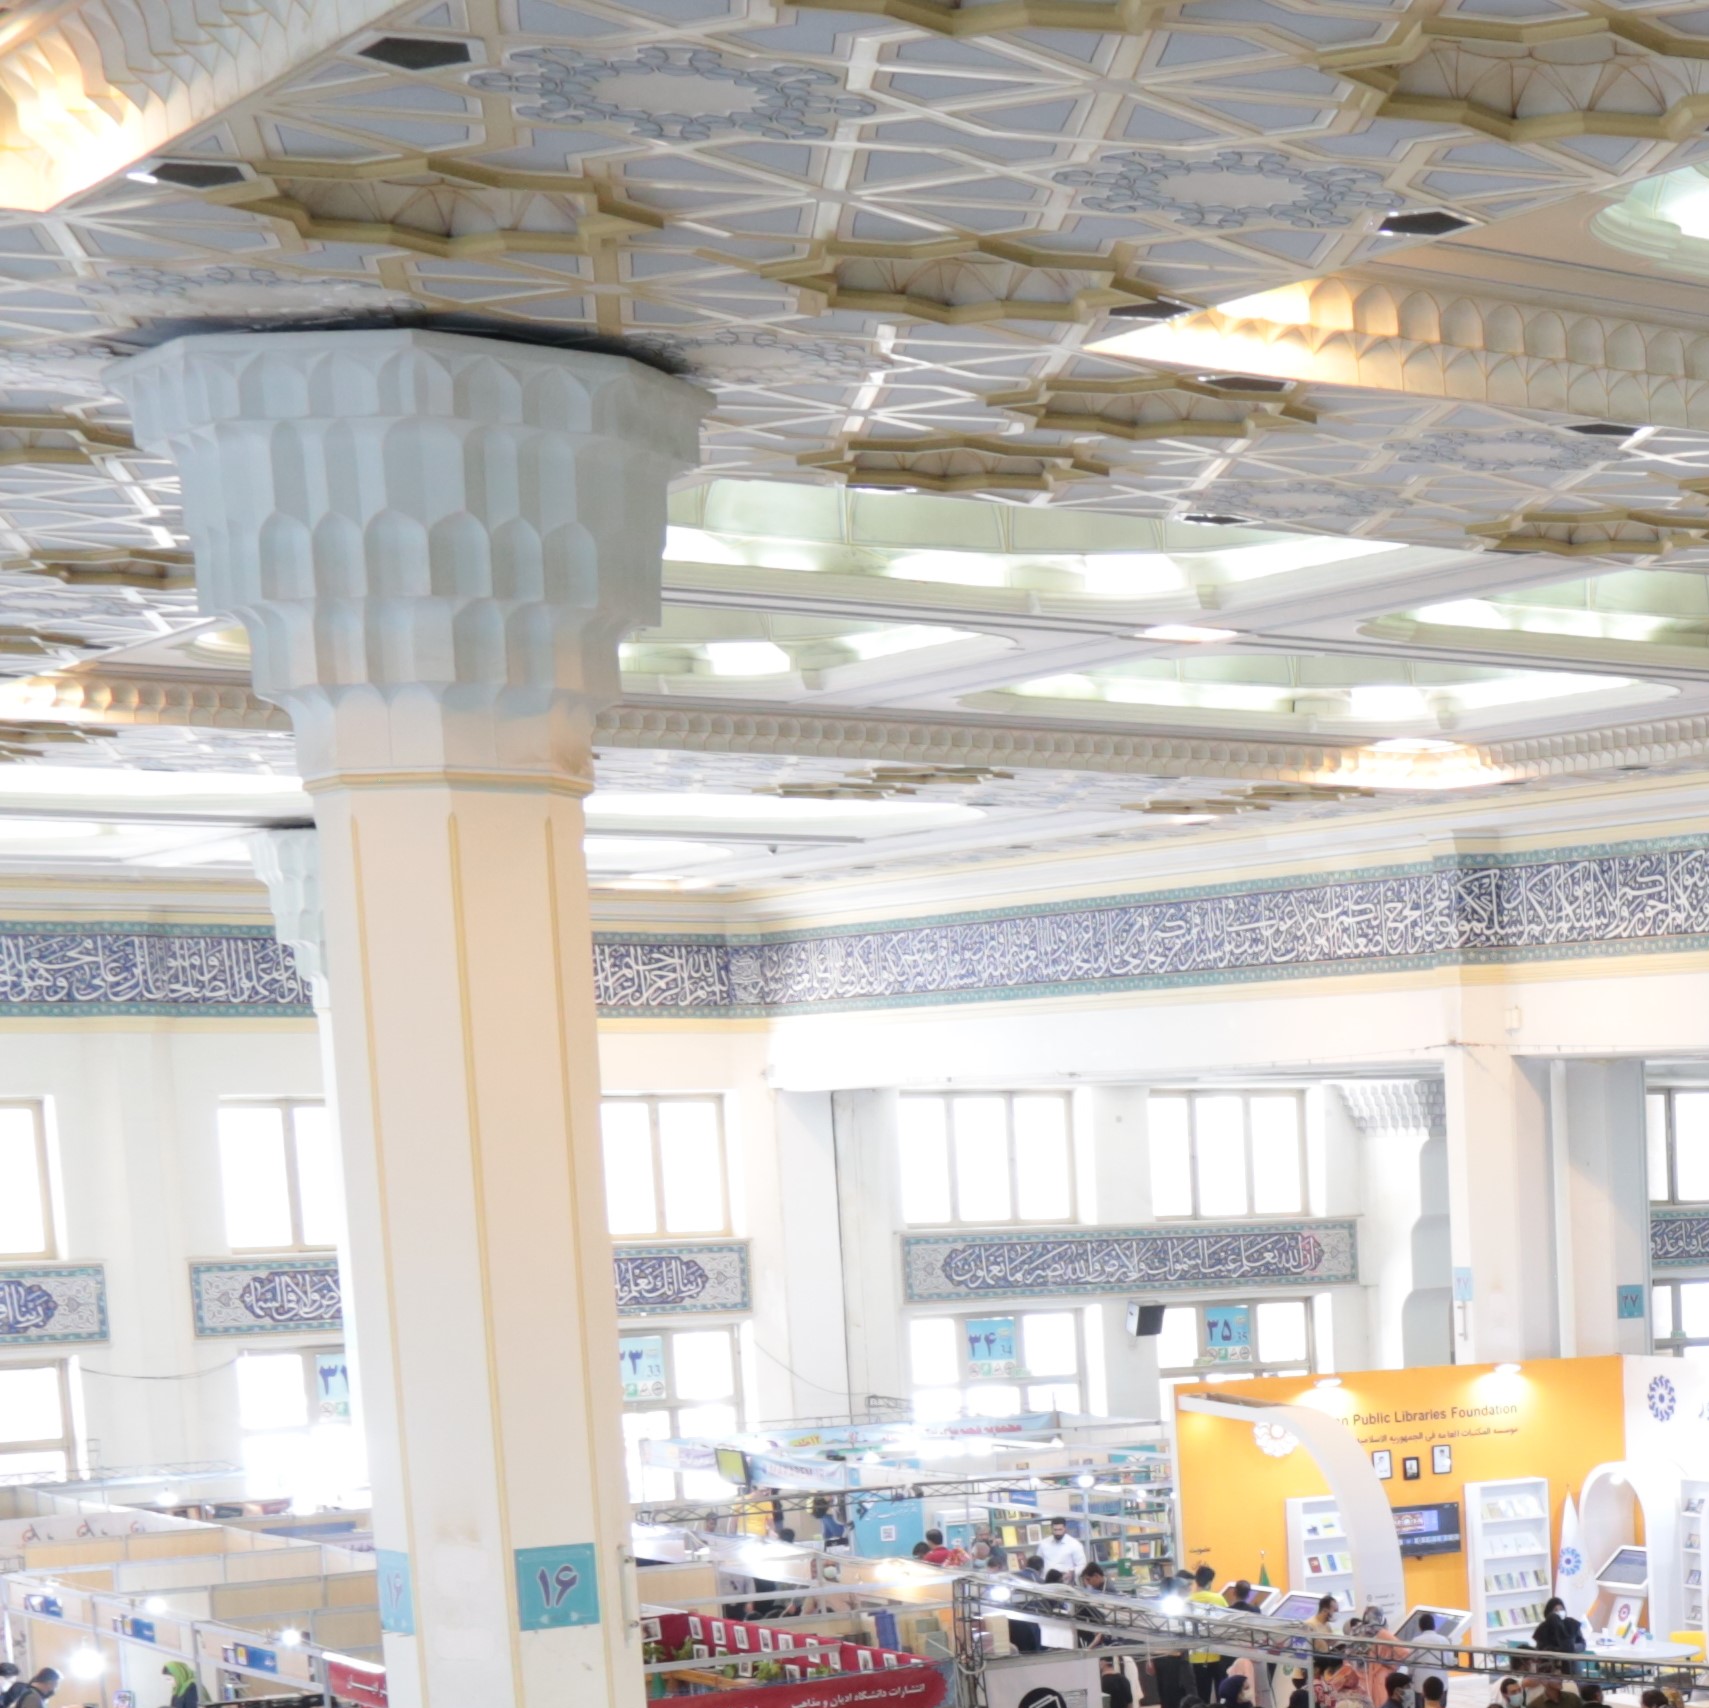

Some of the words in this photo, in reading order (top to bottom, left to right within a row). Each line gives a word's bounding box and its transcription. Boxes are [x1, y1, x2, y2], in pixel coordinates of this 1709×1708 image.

[1353, 1411, 1391, 1426] Public
[1395, 1406, 1447, 1423] Libraries
[1451, 1403, 1518, 1420] Foundation
[538, 1565, 579, 1609] ۱۶
